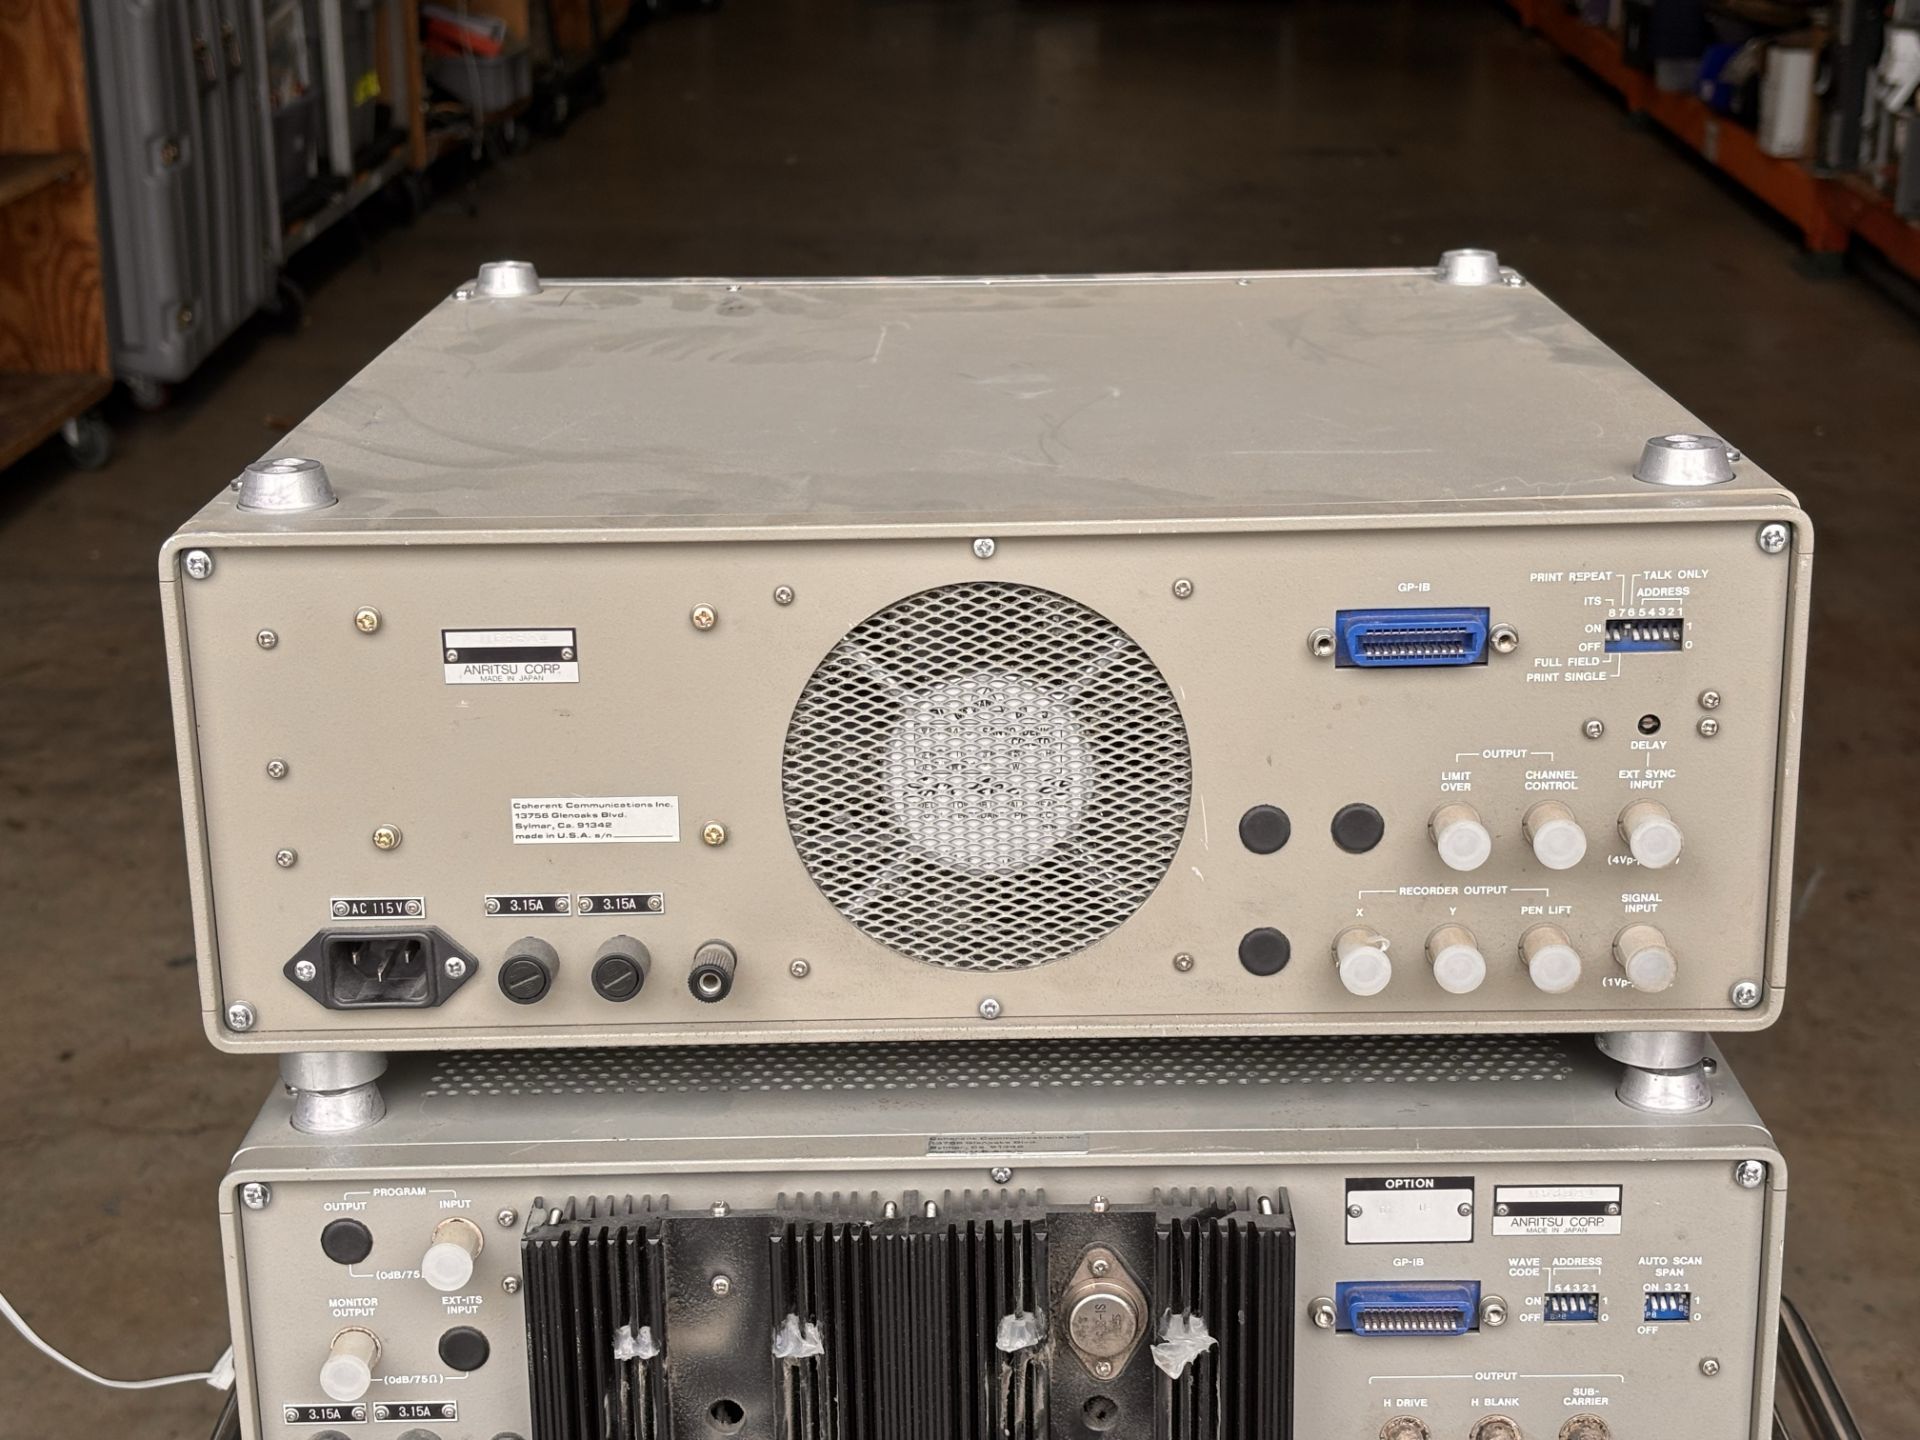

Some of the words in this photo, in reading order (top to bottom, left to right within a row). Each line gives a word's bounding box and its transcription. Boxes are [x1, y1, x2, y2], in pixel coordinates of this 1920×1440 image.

[1530, 572, 1563, 582] PRINT
[1569, 571, 1613, 582] REPEAT
[1643, 570, 1672, 580] TALK
[1678, 569, 1709, 579] ONLY
[1398, 582, 1430, 592] GP-IB
[1636, 586, 1690, 597] ADDRESS
[1584, 596, 1602, 606] ITS
[1584, 624, 1602, 633] ON
[1578, 642, 1601, 652] OFF
[1534, 658, 1562, 667] FULL
[1568, 656, 1600, 666] FIELD
[464, 664, 518, 675] ANRITSU
[1526, 673, 1559, 682] PRINT
[1564, 672, 1607, 682] SINGLE
[1630, 740, 1667, 750] DELAY
[1482, 749, 1528, 759] OUTPUT
[1442, 771, 1472, 781] LIMIT
[1525, 770, 1578, 780] CHANNEL
[1618, 770, 1640, 780] EXT
[1645, 769, 1676, 779] SYNC
[1440, 782, 1472, 792] OVER
[1524, 780, 1578, 791] CONTROL
[1630, 780, 1664, 790] INPUT
[515, 822, 555, 830] Sylmar,
[1400, 886, 1458, 896] RECORDER
[1464, 884, 1508, 895] OUTPUT
[1621, 892, 1662, 903] SIGNAL
[352, 902, 367, 914] AC
[373, 902, 402, 914] 115V
[510, 899, 544, 912] 3.15A
[602, 898, 636, 910] 3.15A
[1625, 904, 1658, 914] INPUT
[1356, 908, 1364, 917] X
[1449, 906, 1457, 916] Y
[1520, 906, 1544, 915] PEN
[1548, 905, 1572, 914] LIFT
[1385, 1178, 1434, 1189] OPTION
[373, 1187, 426, 1196] PROGRAM
[324, 1202, 367, 1211] OUTPUT
[440, 1200, 471, 1209] INPUT
[1510, 1217, 1564, 1227] ANRITSU
[1392, 1258, 1425, 1267] GP-IB
[1508, 1258, 1540, 1266] WAVE
[1552, 1257, 1602, 1266] ADDRESS
[1638, 1256, 1668, 1266] AUTO
[1673, 1256, 1702, 1266] SCAN
[1508, 1268, 1540, 1276] CODE
[1655, 1268, 1684, 1277] SPAN
[1642, 1283, 1660, 1292] ON
[328, 1298, 378, 1308] MONITOR
[442, 1296, 483, 1305] EXT-ITS
[1525, 1297, 1542, 1306] ON
[332, 1307, 376, 1317] OUTPUT
[447, 1305, 479, 1315] INPUT
[1519, 1313, 1541, 1322] OFF
[1637, 1326, 1658, 1334] OFF
[384, 1374, 444, 1385] (0dB/75Ω)
[1474, 1372, 1518, 1381] OUTPUT
[1572, 1387, 1600, 1396] SUB-
[1384, 1398, 1391, 1408] H
[1396, 1398, 1428, 1408] DRIVE
[1471, 1398, 1479, 1406] H
[1484, 1398, 1519, 1406] BLANK
[1563, 1396, 1609, 1406] CARRIER
[308, 1408, 342, 1420] 3.15A
[398, 1406, 432, 1418] 3.15A
